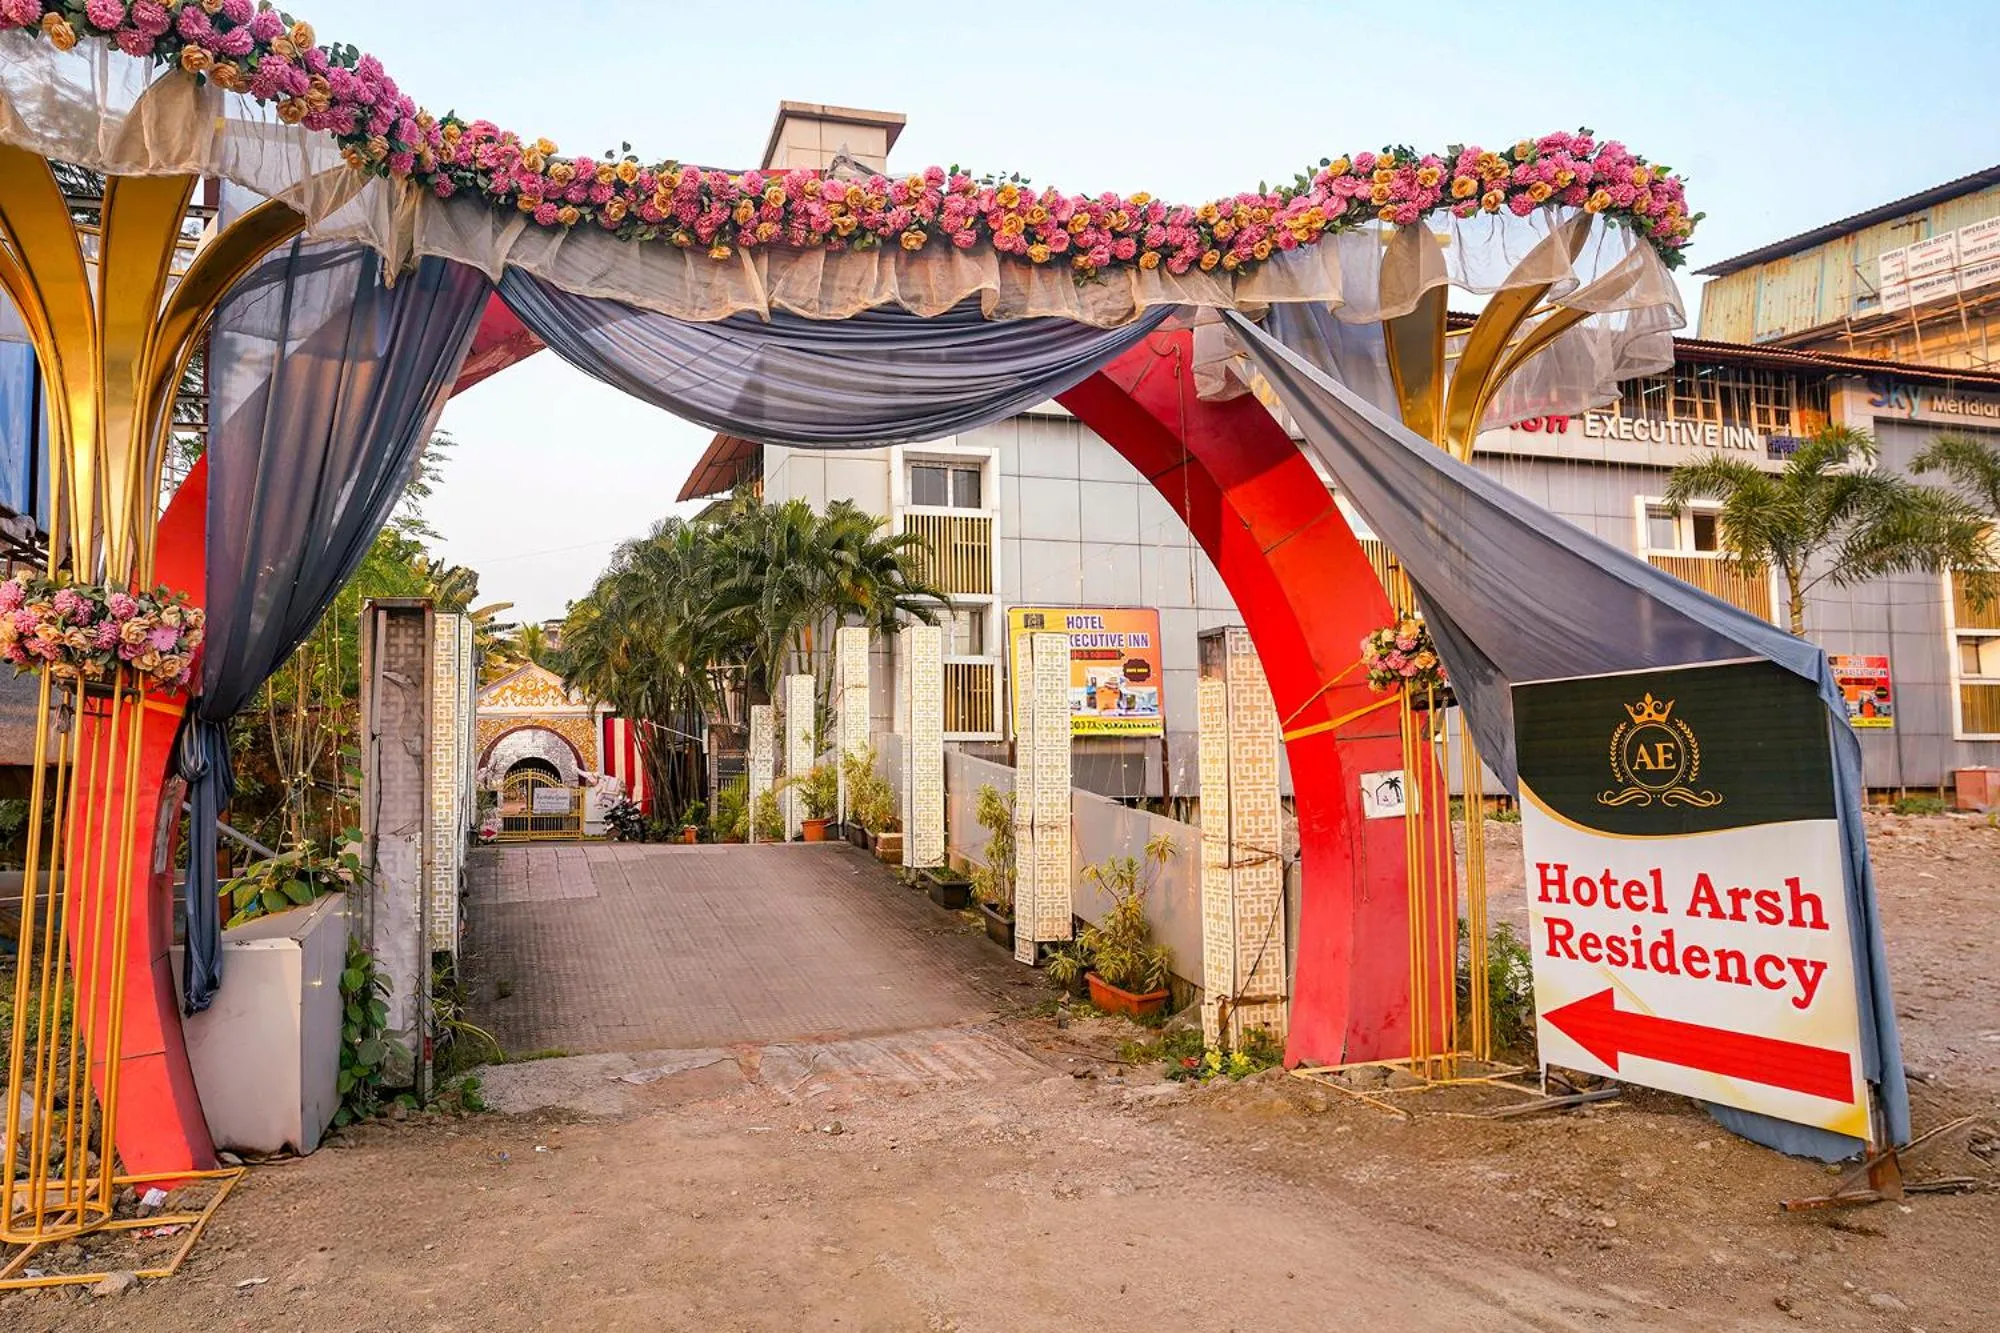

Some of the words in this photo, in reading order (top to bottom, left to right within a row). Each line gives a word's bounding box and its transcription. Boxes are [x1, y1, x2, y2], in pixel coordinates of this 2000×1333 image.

[1584, 412, 1718, 447] EXECUTIVE
[1722, 425, 1759, 450] INN
[1066, 615, 1104, 629] HOTEL
[1128, 633, 1149, 647] INN
[1633, 742, 1677, 770] AE
[1536, 862, 1668, 914] Hotel
[1686, 872, 1830, 930] Arsh
[1543, 916, 1828, 1009] Residency
